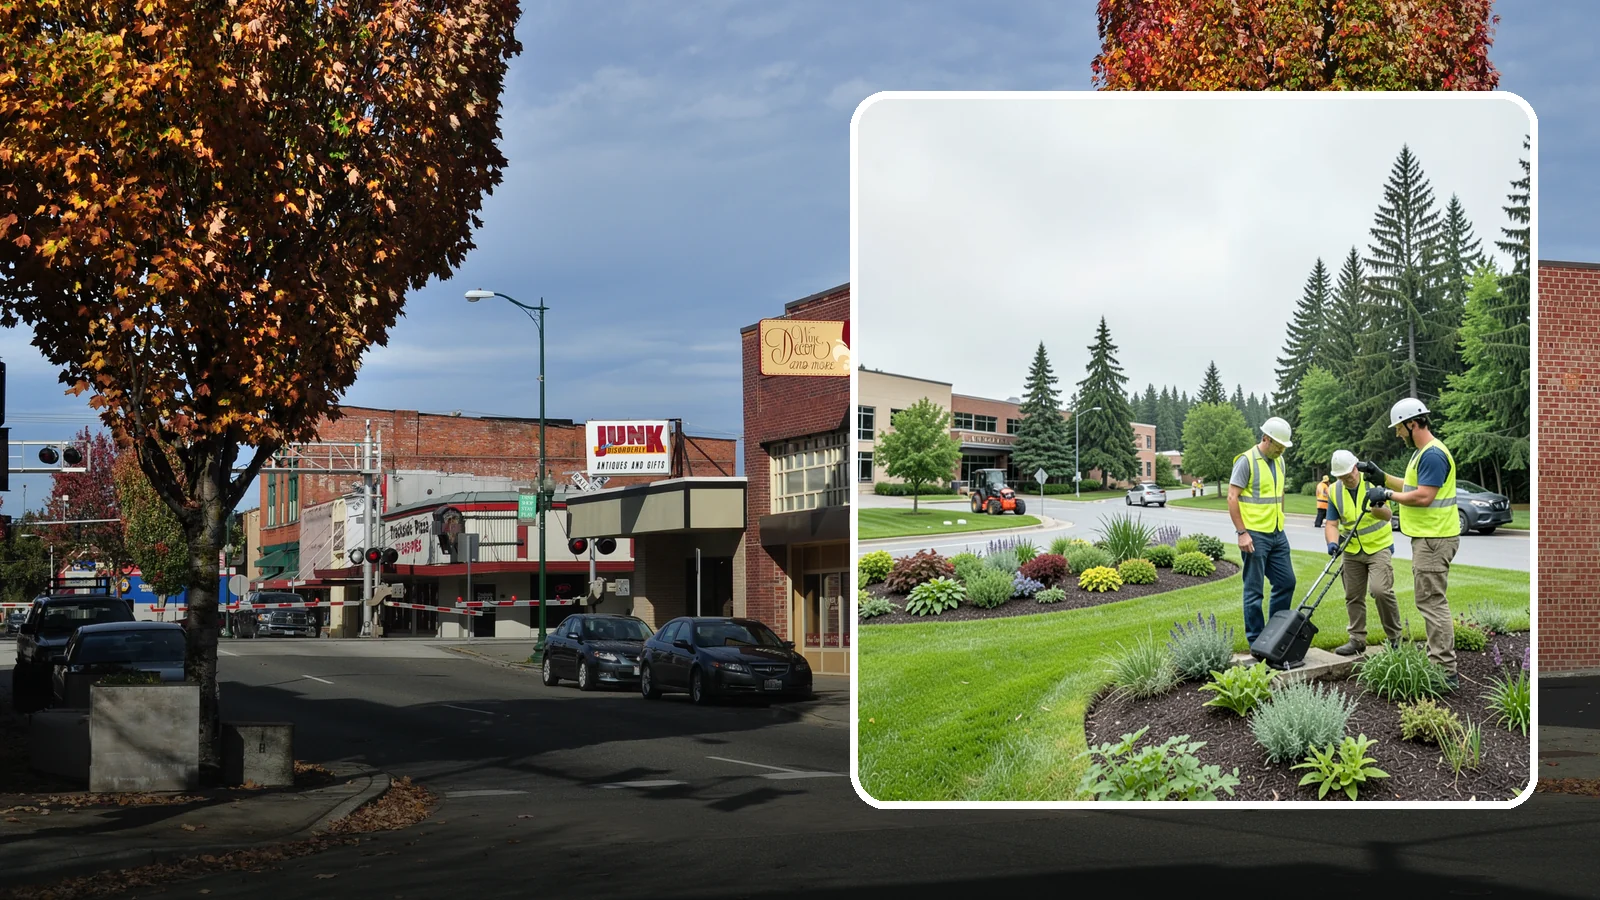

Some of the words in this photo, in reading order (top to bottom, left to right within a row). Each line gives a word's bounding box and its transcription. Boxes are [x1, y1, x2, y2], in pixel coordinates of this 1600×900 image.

[765, 328, 830, 365] Decor
[596, 426, 664, 457] JUNK
[607, 446, 646, 454] DISORDERLY
[597, 461, 628, 470] ANTIQUES
[631, 461, 643, 470] AND
[647, 460, 665, 469] GIFTS
